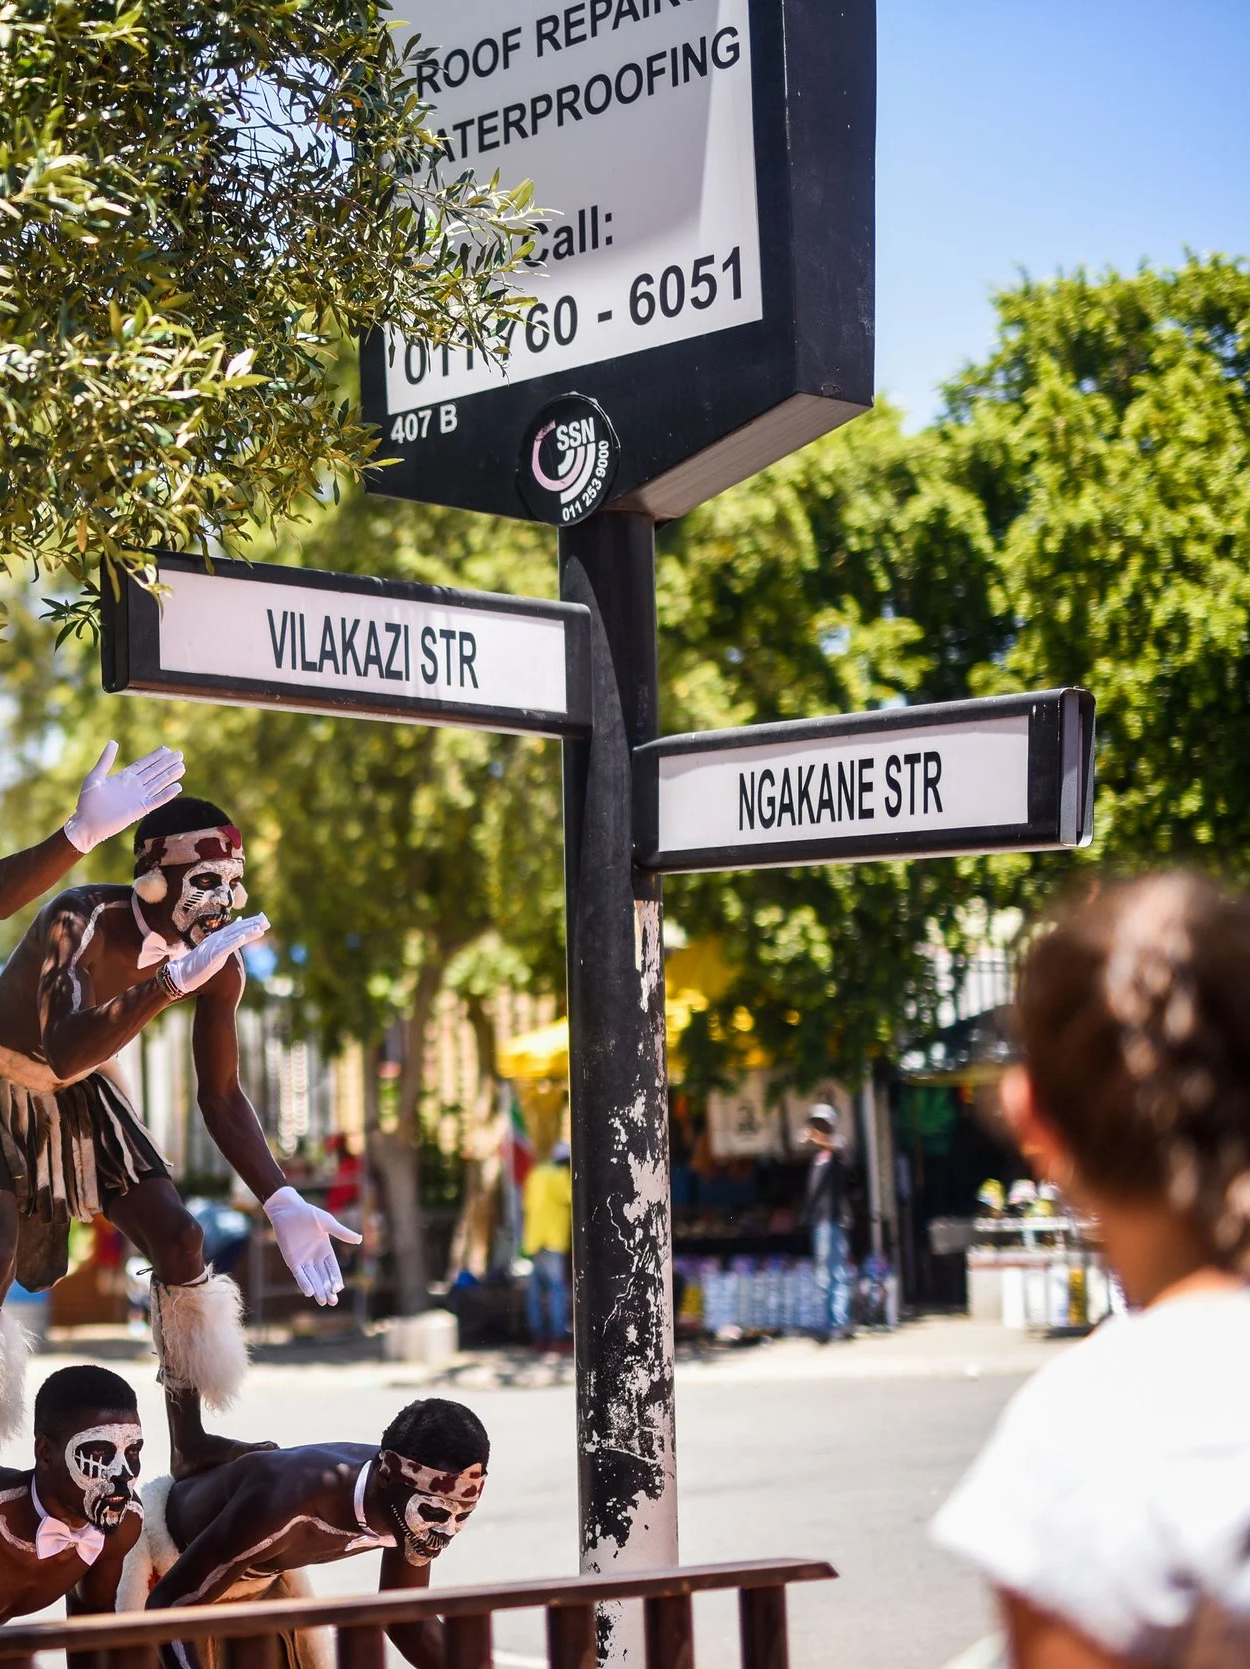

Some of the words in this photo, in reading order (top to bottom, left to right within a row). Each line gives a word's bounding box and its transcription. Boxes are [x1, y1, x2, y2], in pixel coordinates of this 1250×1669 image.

[416, 26, 522, 98] ROOF
[536, 0, 694, 58] REPA
[395, 26, 740, 174] ATERPROOFING
[522, 205, 613, 268] Call:
[629, 246, 741, 326] 6051
[390, 409, 432, 444] 407
[440, 404, 458, 434] B
[556, 417, 595, 451] SSN
[562, 500, 583, 521] 011
[582, 478, 602, 507] 253
[595, 440, 610, 478] 9000
[266, 609, 410, 682] VILAKAZI
[420, 626, 479, 689] STR
[738, 757, 875, 831] NGAKANE
[884, 751, 944, 818] STR
